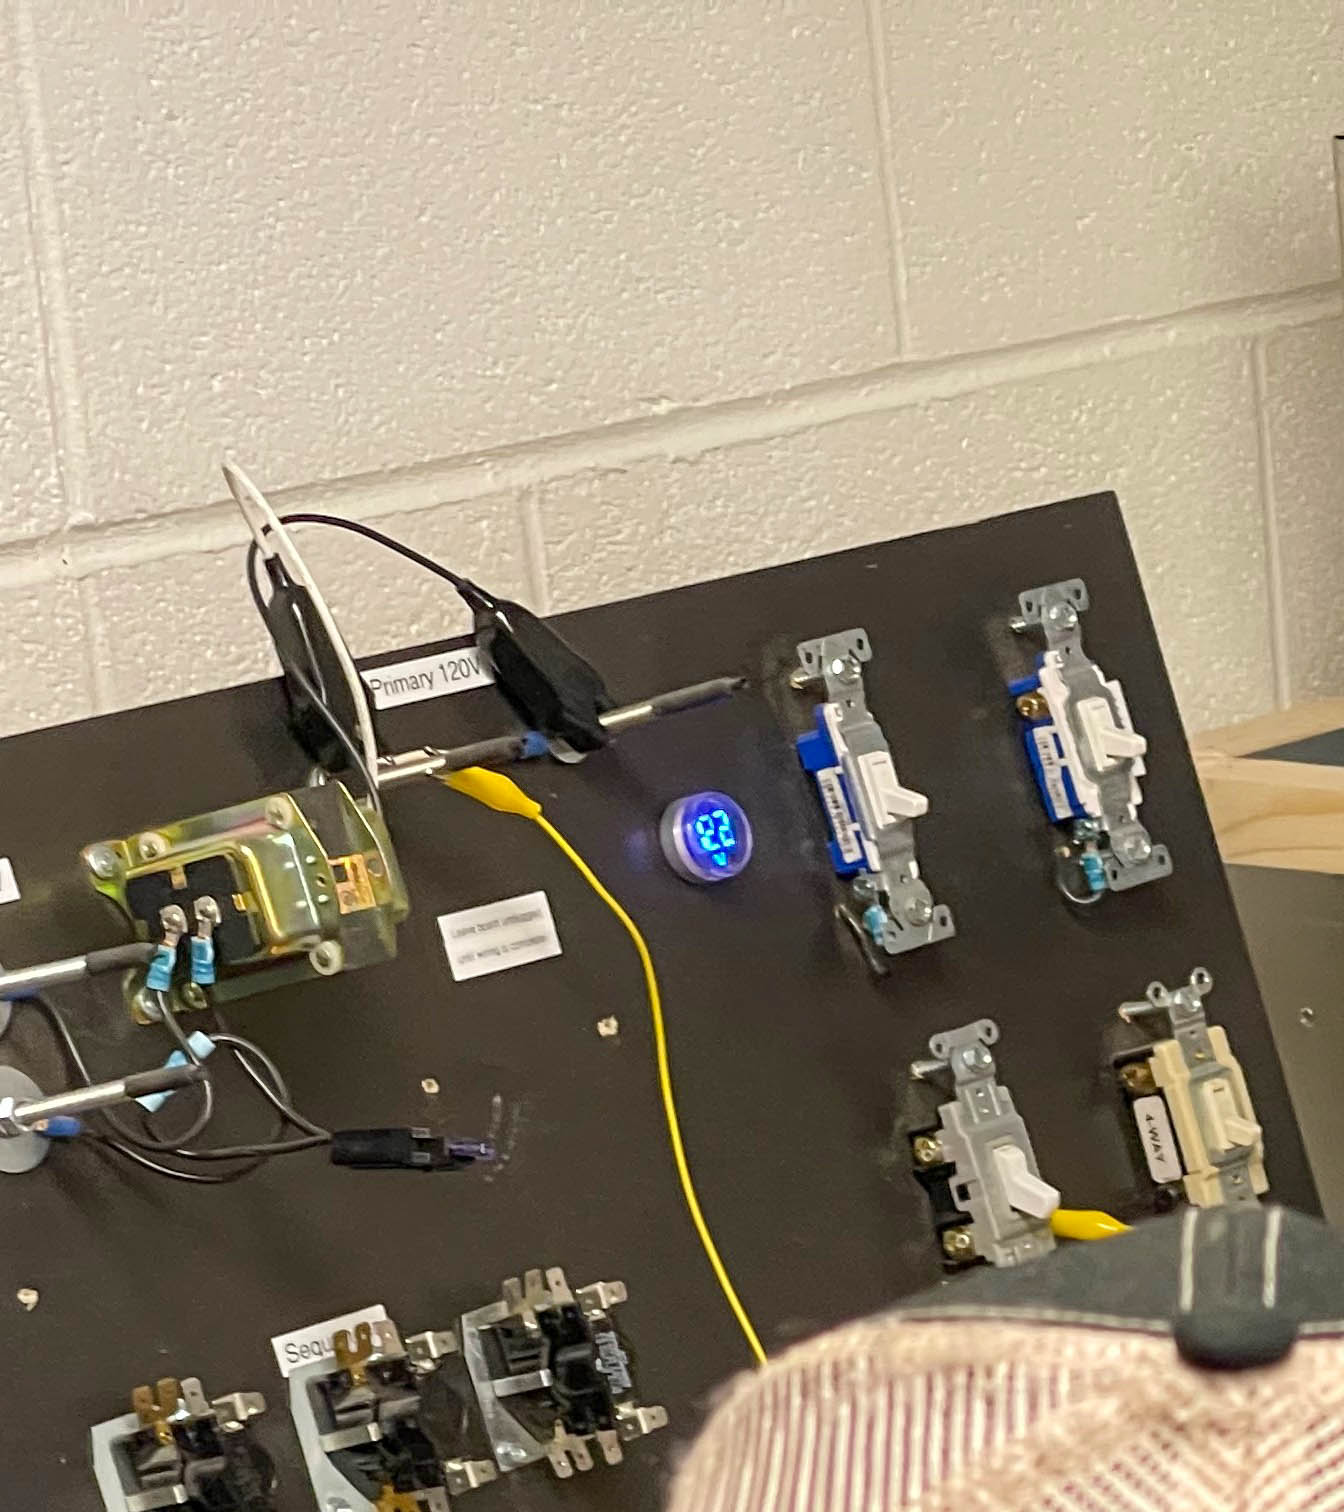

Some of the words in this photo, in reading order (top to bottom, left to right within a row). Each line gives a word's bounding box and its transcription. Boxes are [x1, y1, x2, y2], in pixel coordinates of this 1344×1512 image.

[369, 671, 434, 697] Primary
[438, 655, 481, 682] 120V
[284, 1340, 335, 1364] Sequ
